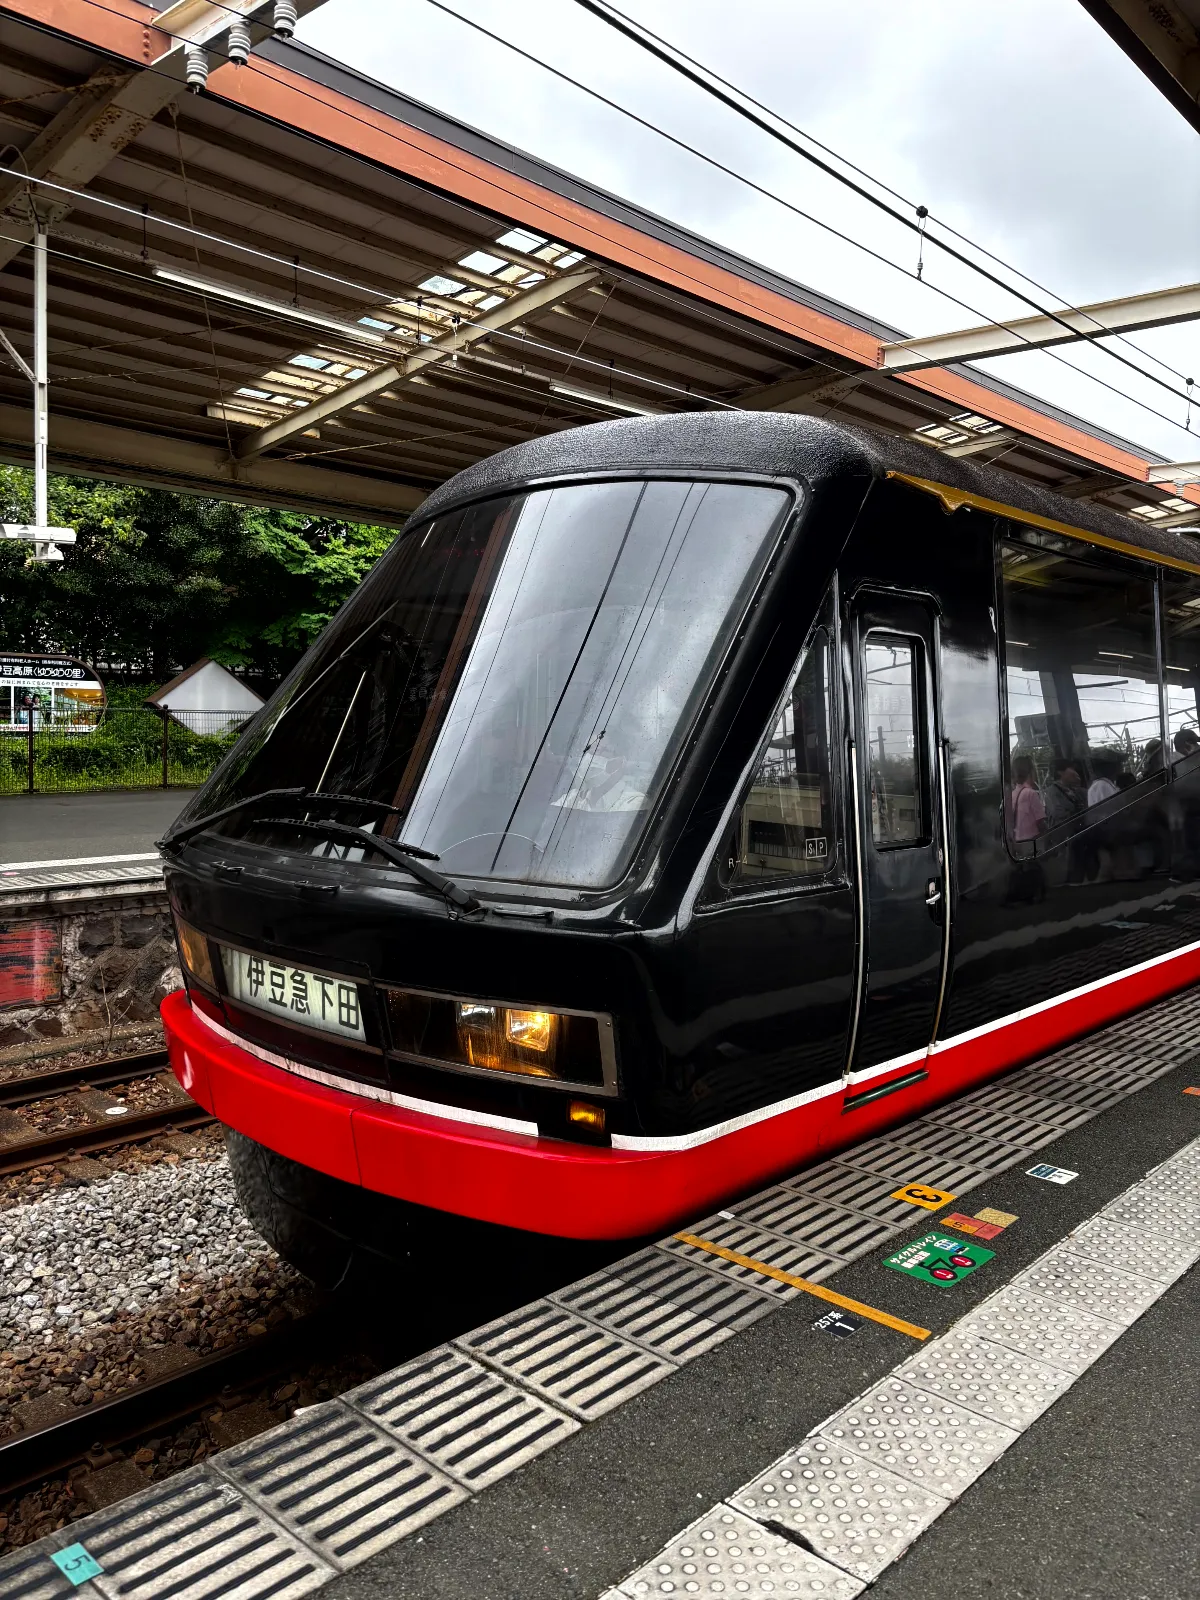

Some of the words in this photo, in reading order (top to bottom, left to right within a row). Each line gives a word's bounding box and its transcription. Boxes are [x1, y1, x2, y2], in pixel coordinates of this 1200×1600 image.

[247, 955, 360, 1031] 伊豆急下田
[905, 1188, 943, 1203] 3
[889, 1234, 937, 1265] サイクルトレイン
[834, 1321, 856, 1332] 1
[64, 1554, 92, 1571] 5
